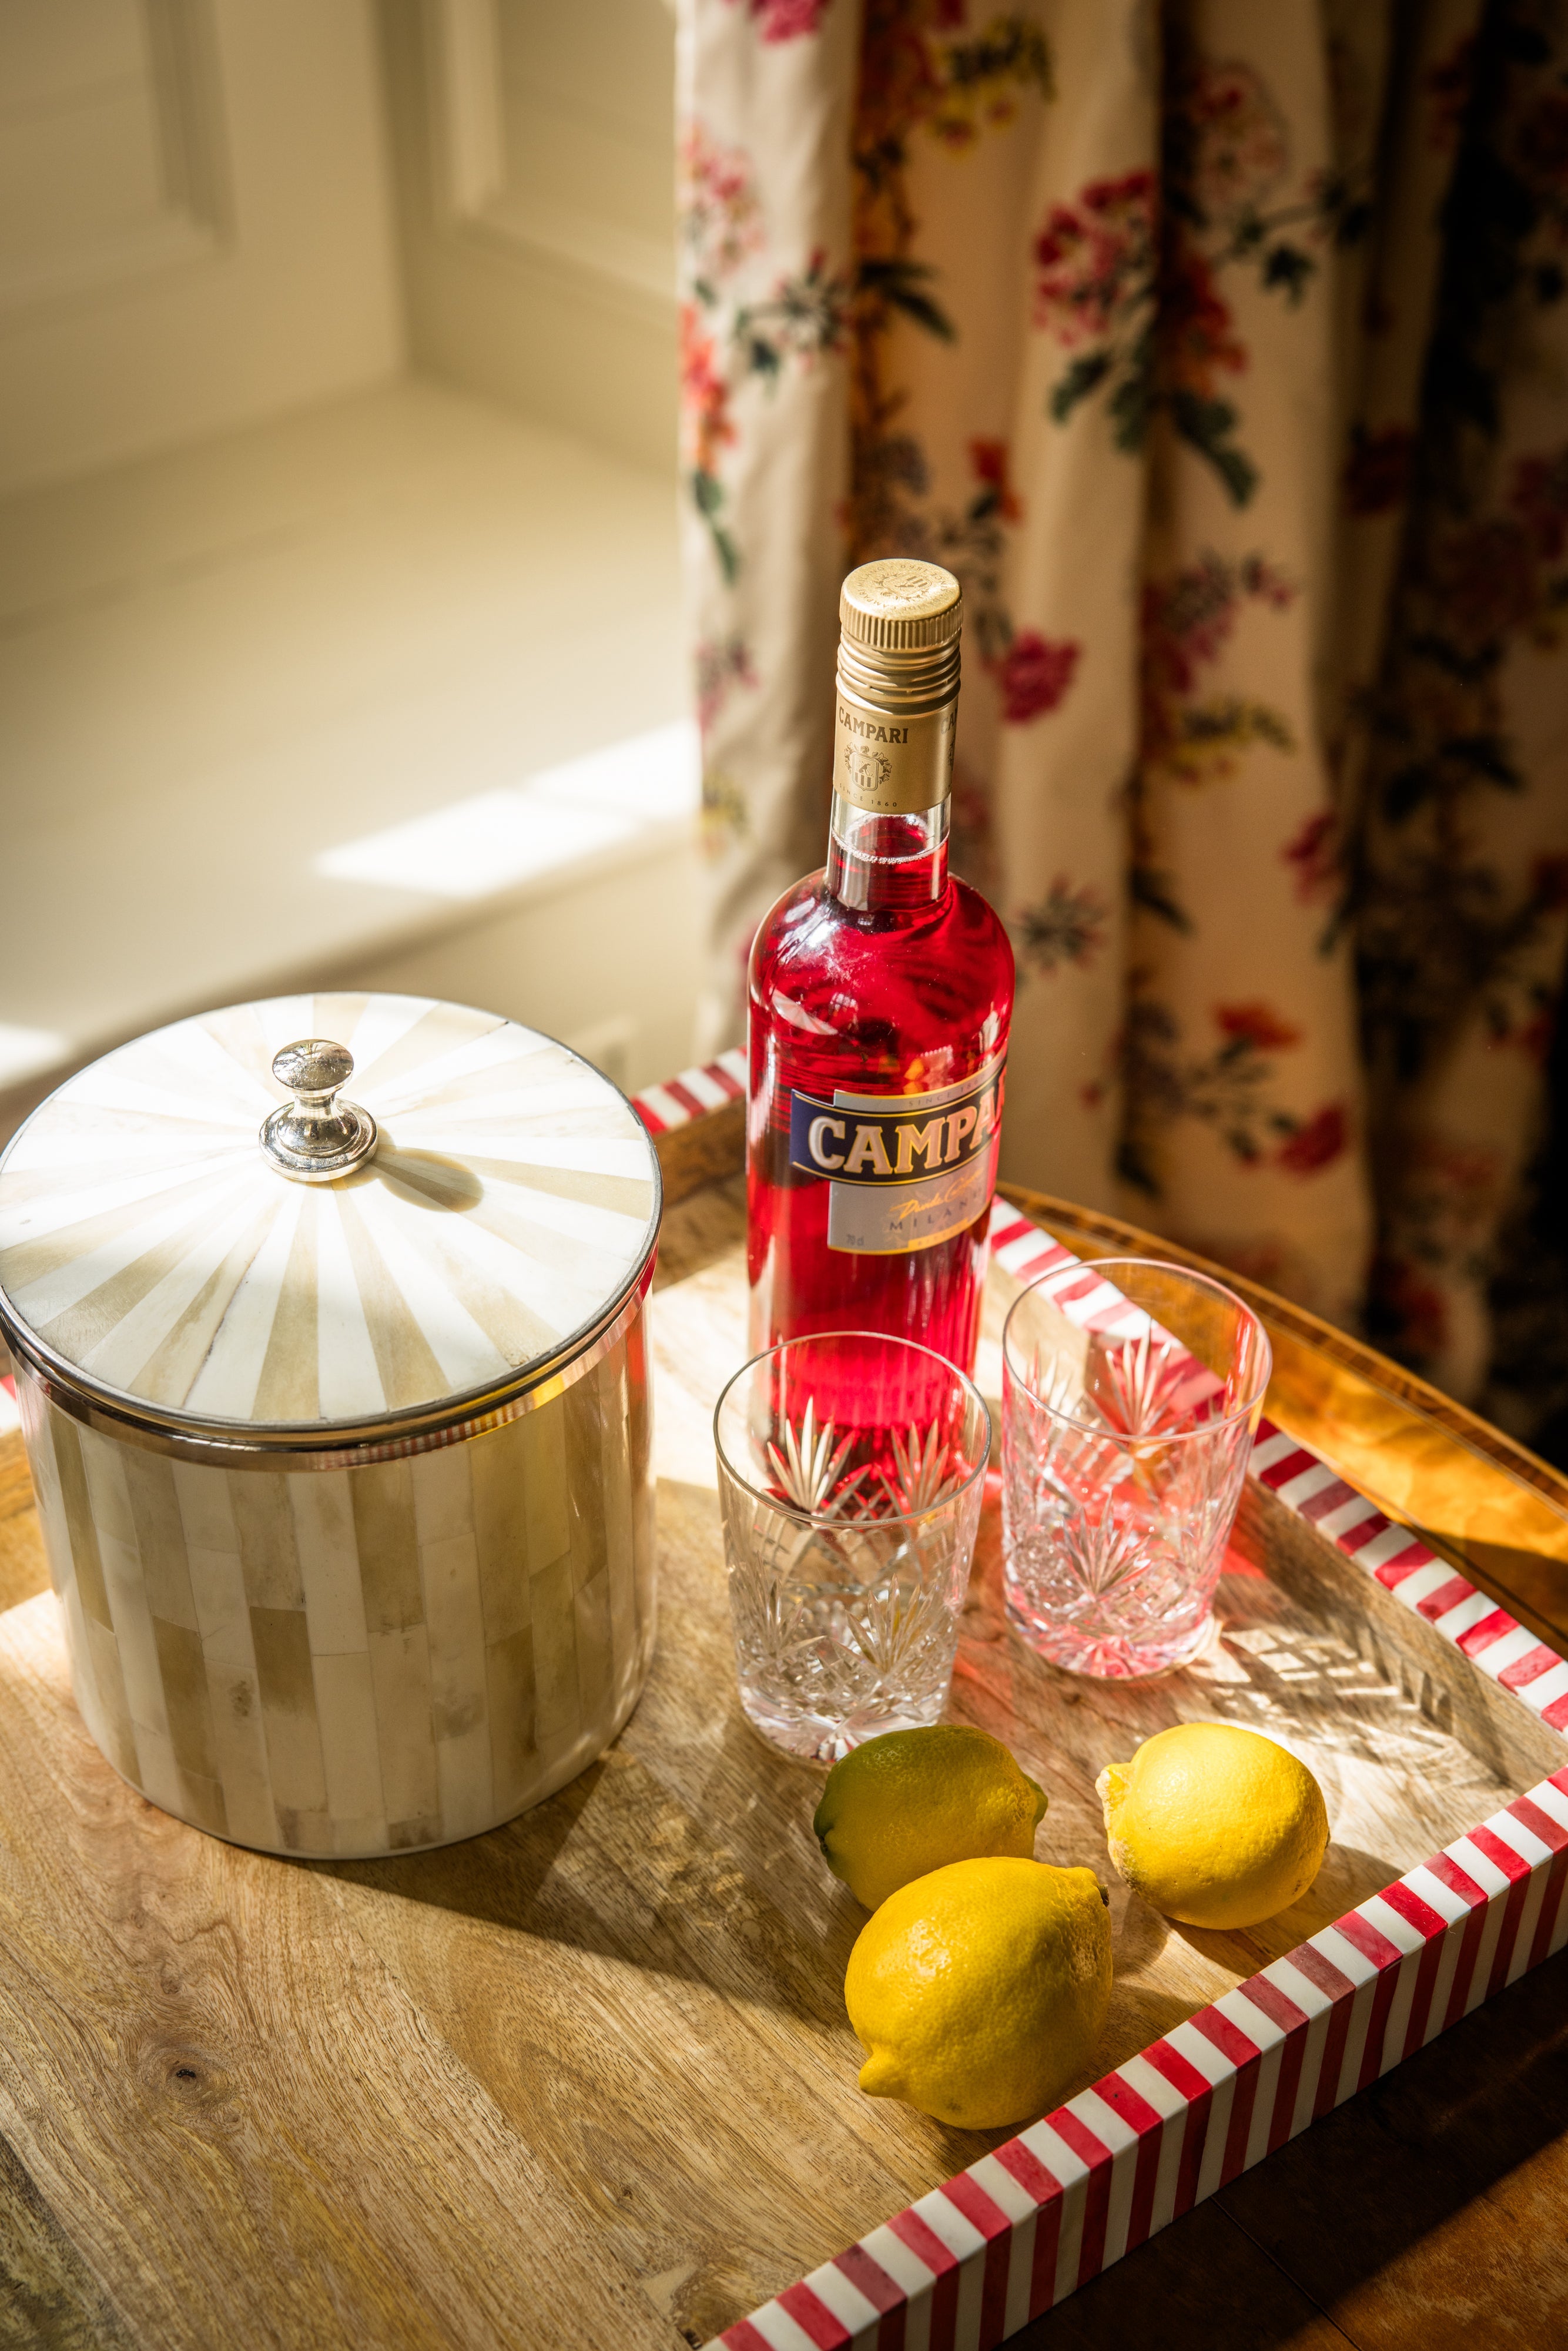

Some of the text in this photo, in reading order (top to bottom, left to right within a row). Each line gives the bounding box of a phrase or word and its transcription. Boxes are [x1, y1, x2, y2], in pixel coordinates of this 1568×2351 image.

[857, 566, 885, 588] MILANO
[930, 572, 948, 592] SINCE
[839, 706, 909, 744] CAMPARI
[839, 783, 863, 801] SINCE
[908, 1091, 951, 1107] SINCE
